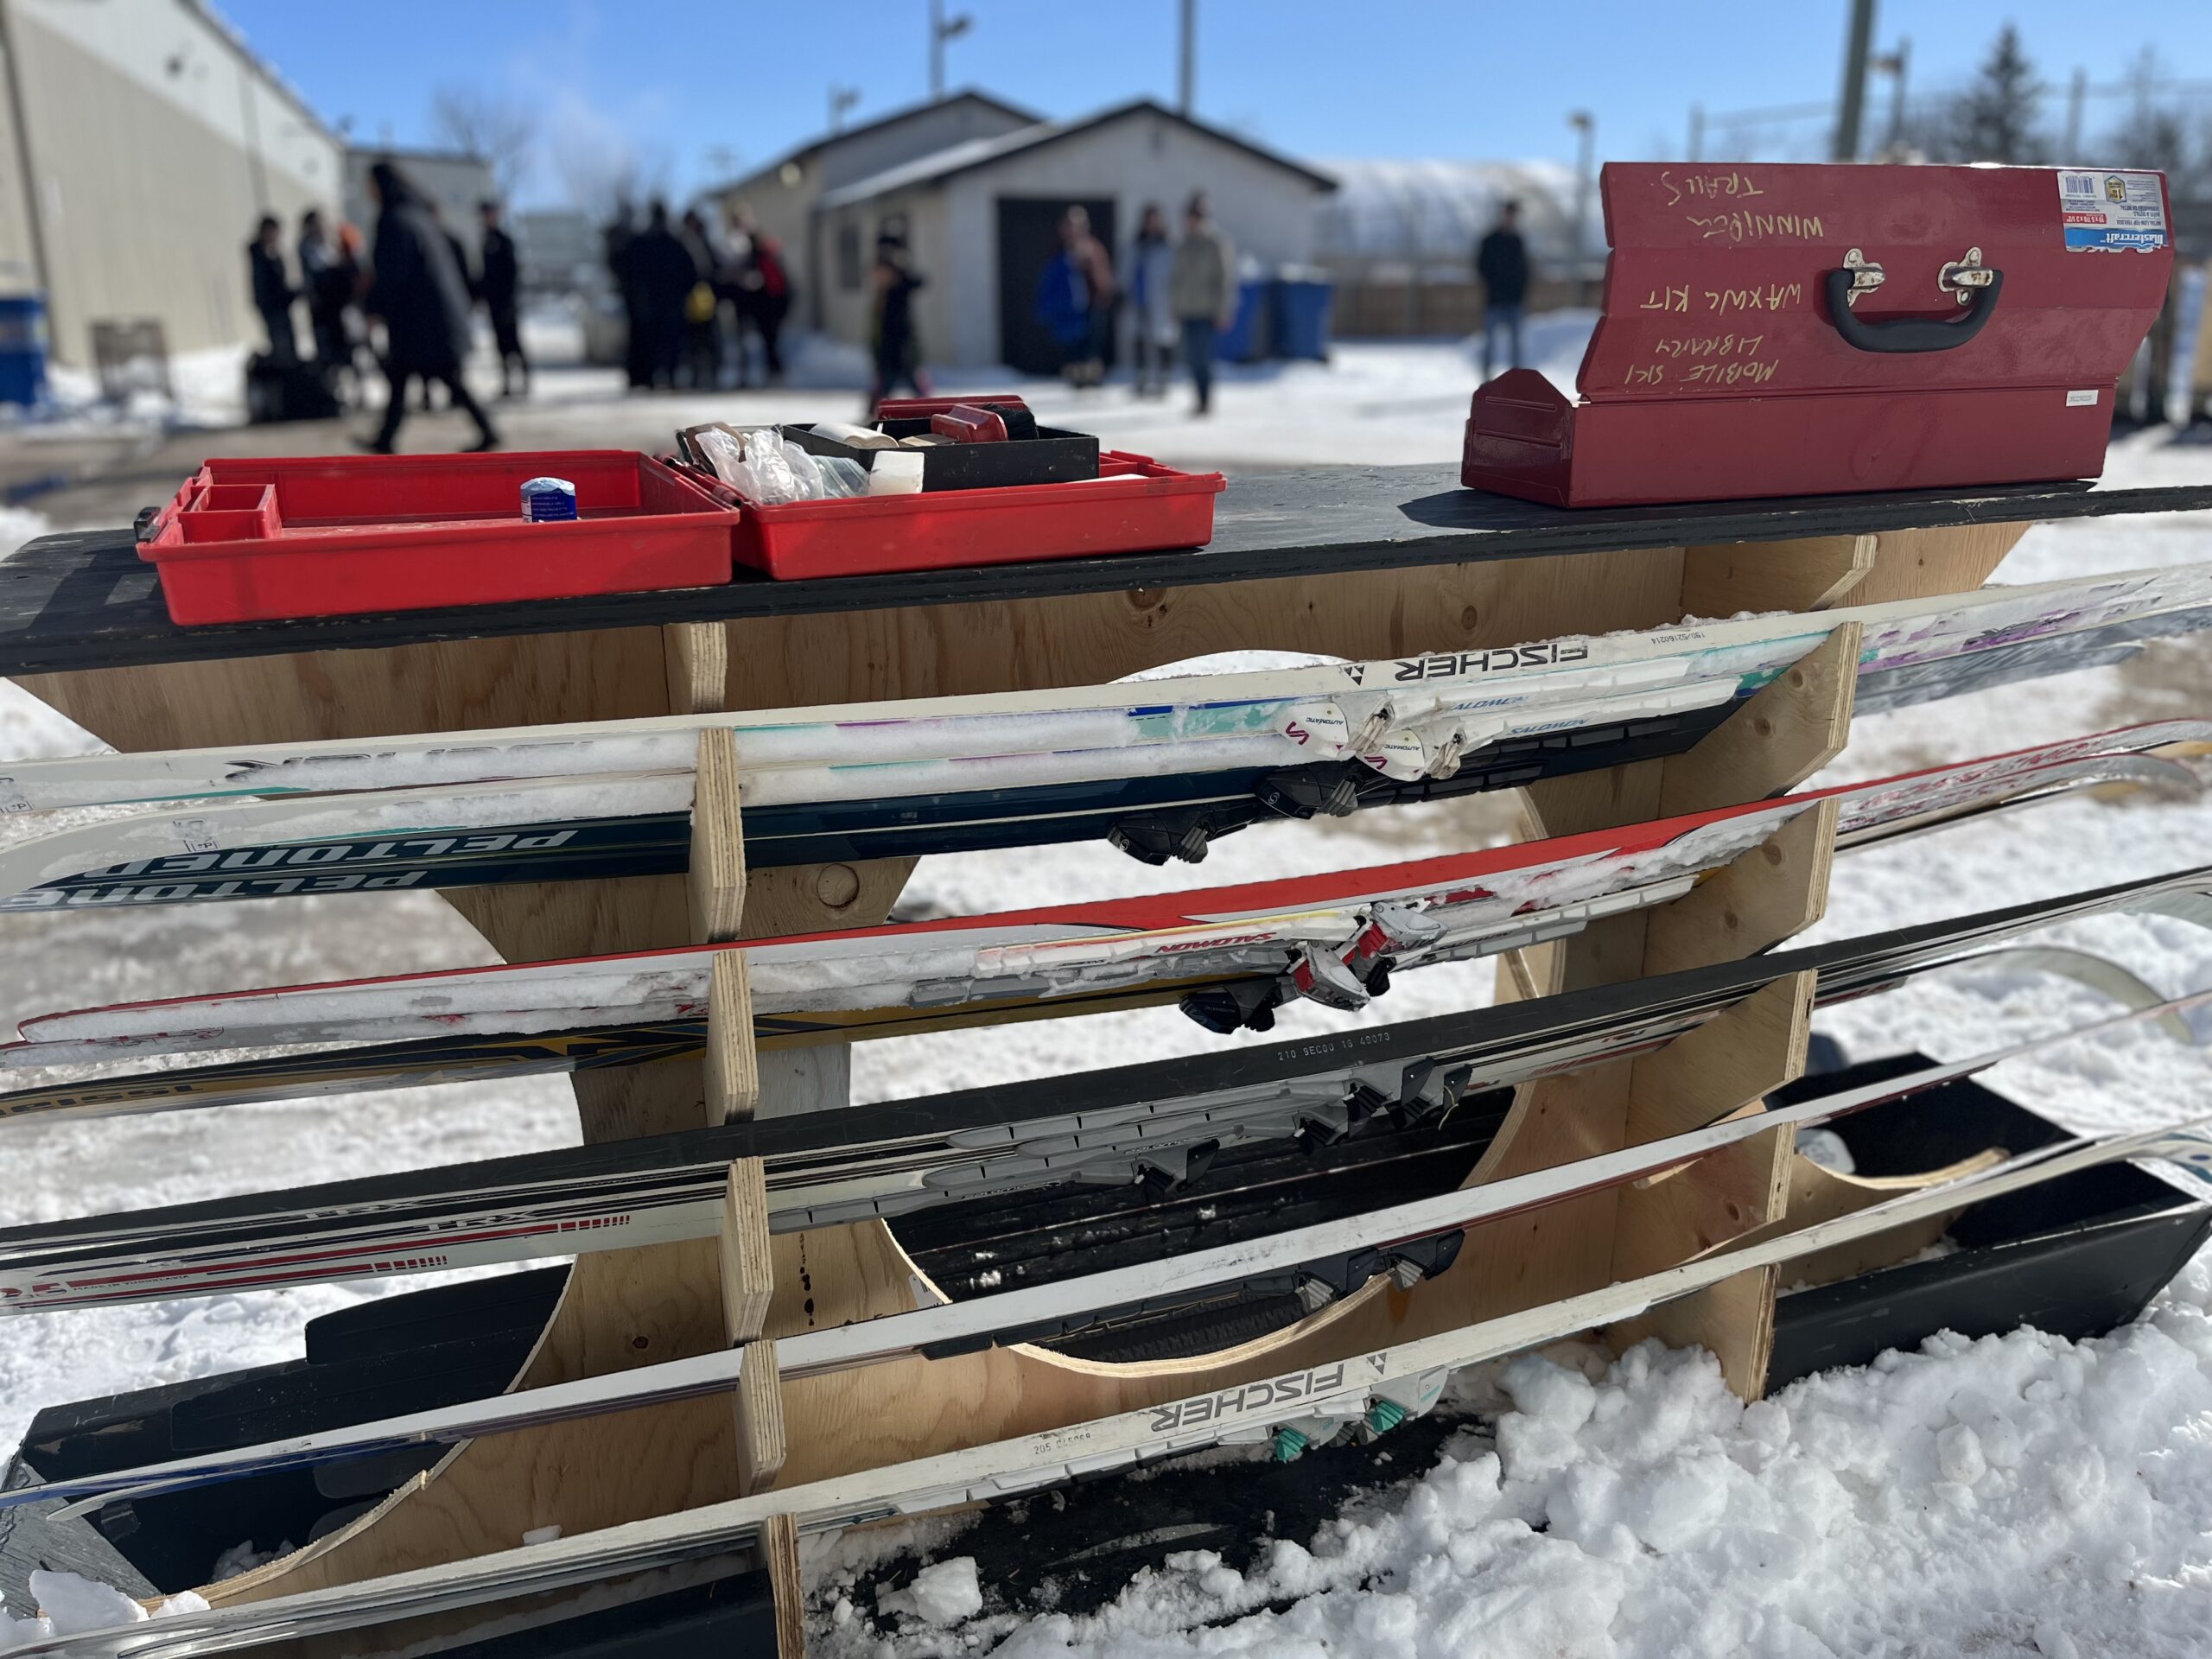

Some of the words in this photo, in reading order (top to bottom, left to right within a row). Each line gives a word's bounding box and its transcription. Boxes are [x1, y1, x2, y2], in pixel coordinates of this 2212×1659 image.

[1661, 171, 1764, 206] TRAILS
[2106, 232, 2164, 245] Mastercraft
[1639, 284, 1689, 313] KIT
[1655, 334, 1764, 359] LIBRARY
[1624, 364, 1664, 385] SKI
[1679, 359, 1780, 384] MOBILE
[1394, 643, 1589, 682] FISCHER
[1306, 716, 1344, 726] AUTOMATIC
[1511, 718, 1589, 734] SALOMON
[83, 830, 580, 879] PELTONEN
[1154, 931, 1278, 954] SALOMON
[1277, 1049, 1297, 1061] 210
[1150, 1363, 1344, 1433] FISCHER
[1033, 1442, 1052, 1455] 205
